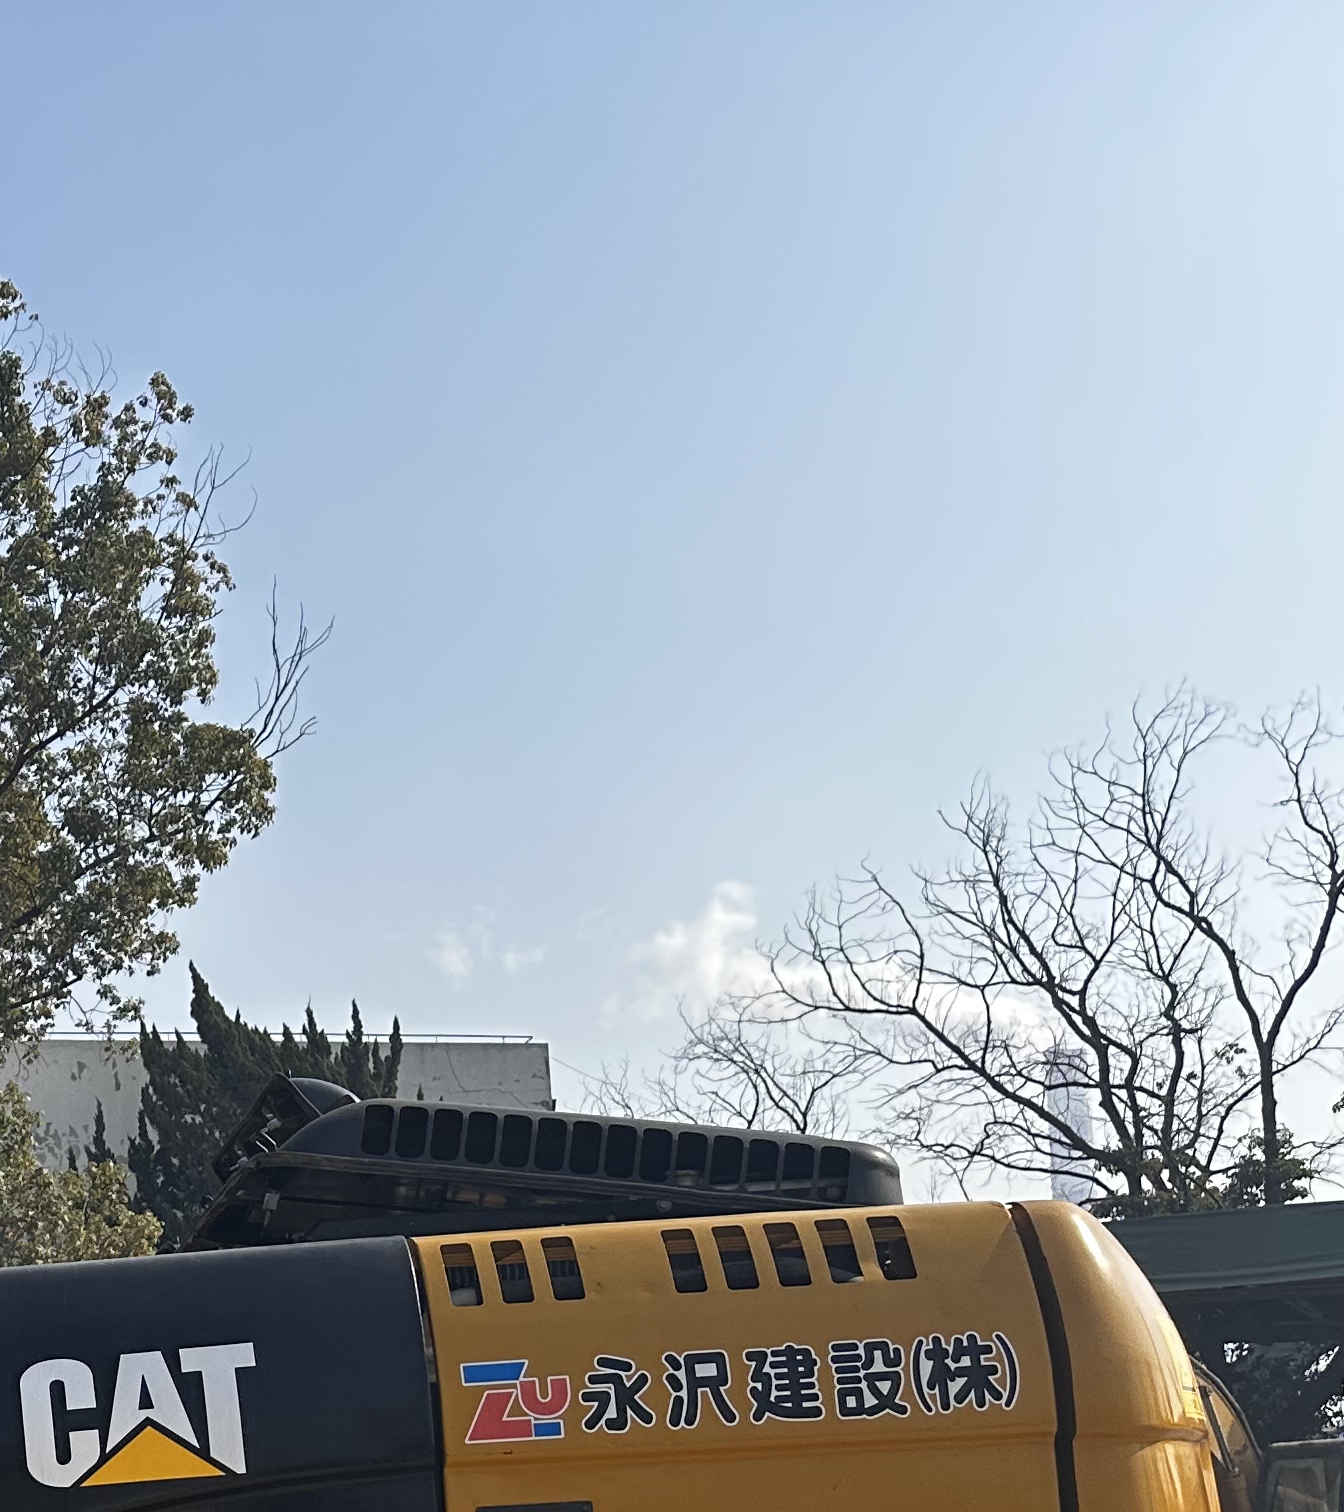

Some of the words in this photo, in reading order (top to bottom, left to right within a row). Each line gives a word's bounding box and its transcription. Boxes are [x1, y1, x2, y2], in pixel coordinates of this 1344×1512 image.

[20, 1342, 256, 1487] CAT
[581, 1332, 1020, 1433] 永沢建設(株)
